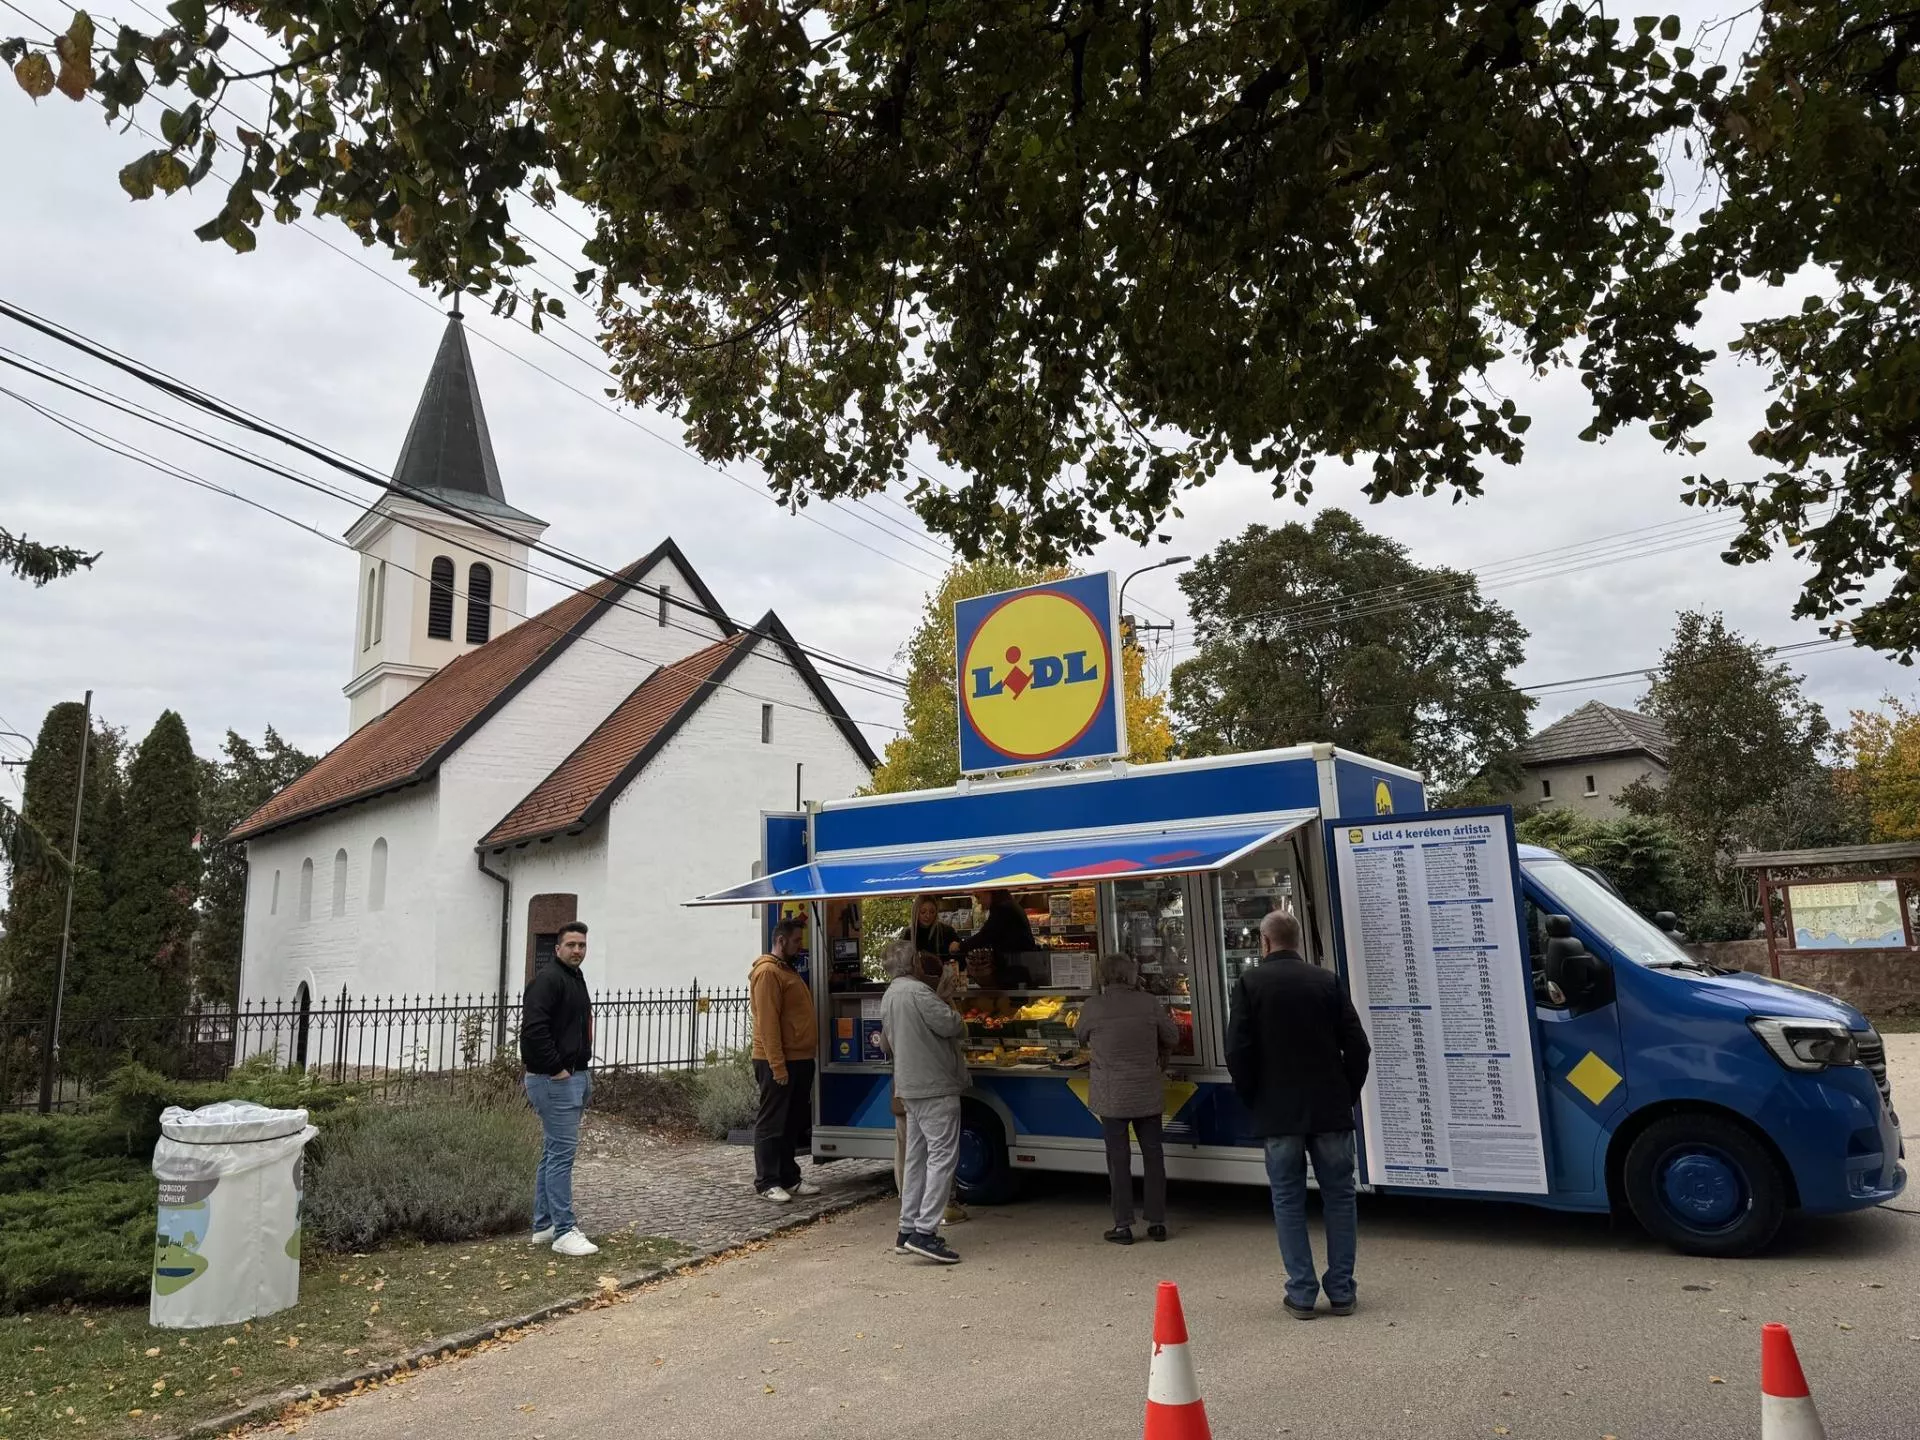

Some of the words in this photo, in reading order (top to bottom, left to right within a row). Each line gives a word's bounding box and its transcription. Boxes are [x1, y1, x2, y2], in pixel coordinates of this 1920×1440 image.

[1372, 830, 1393, 841] Lidl
[1396, 830, 1402, 839] 4
[1406, 826, 1450, 838] keréken
[1454, 824, 1490, 834] árlista
